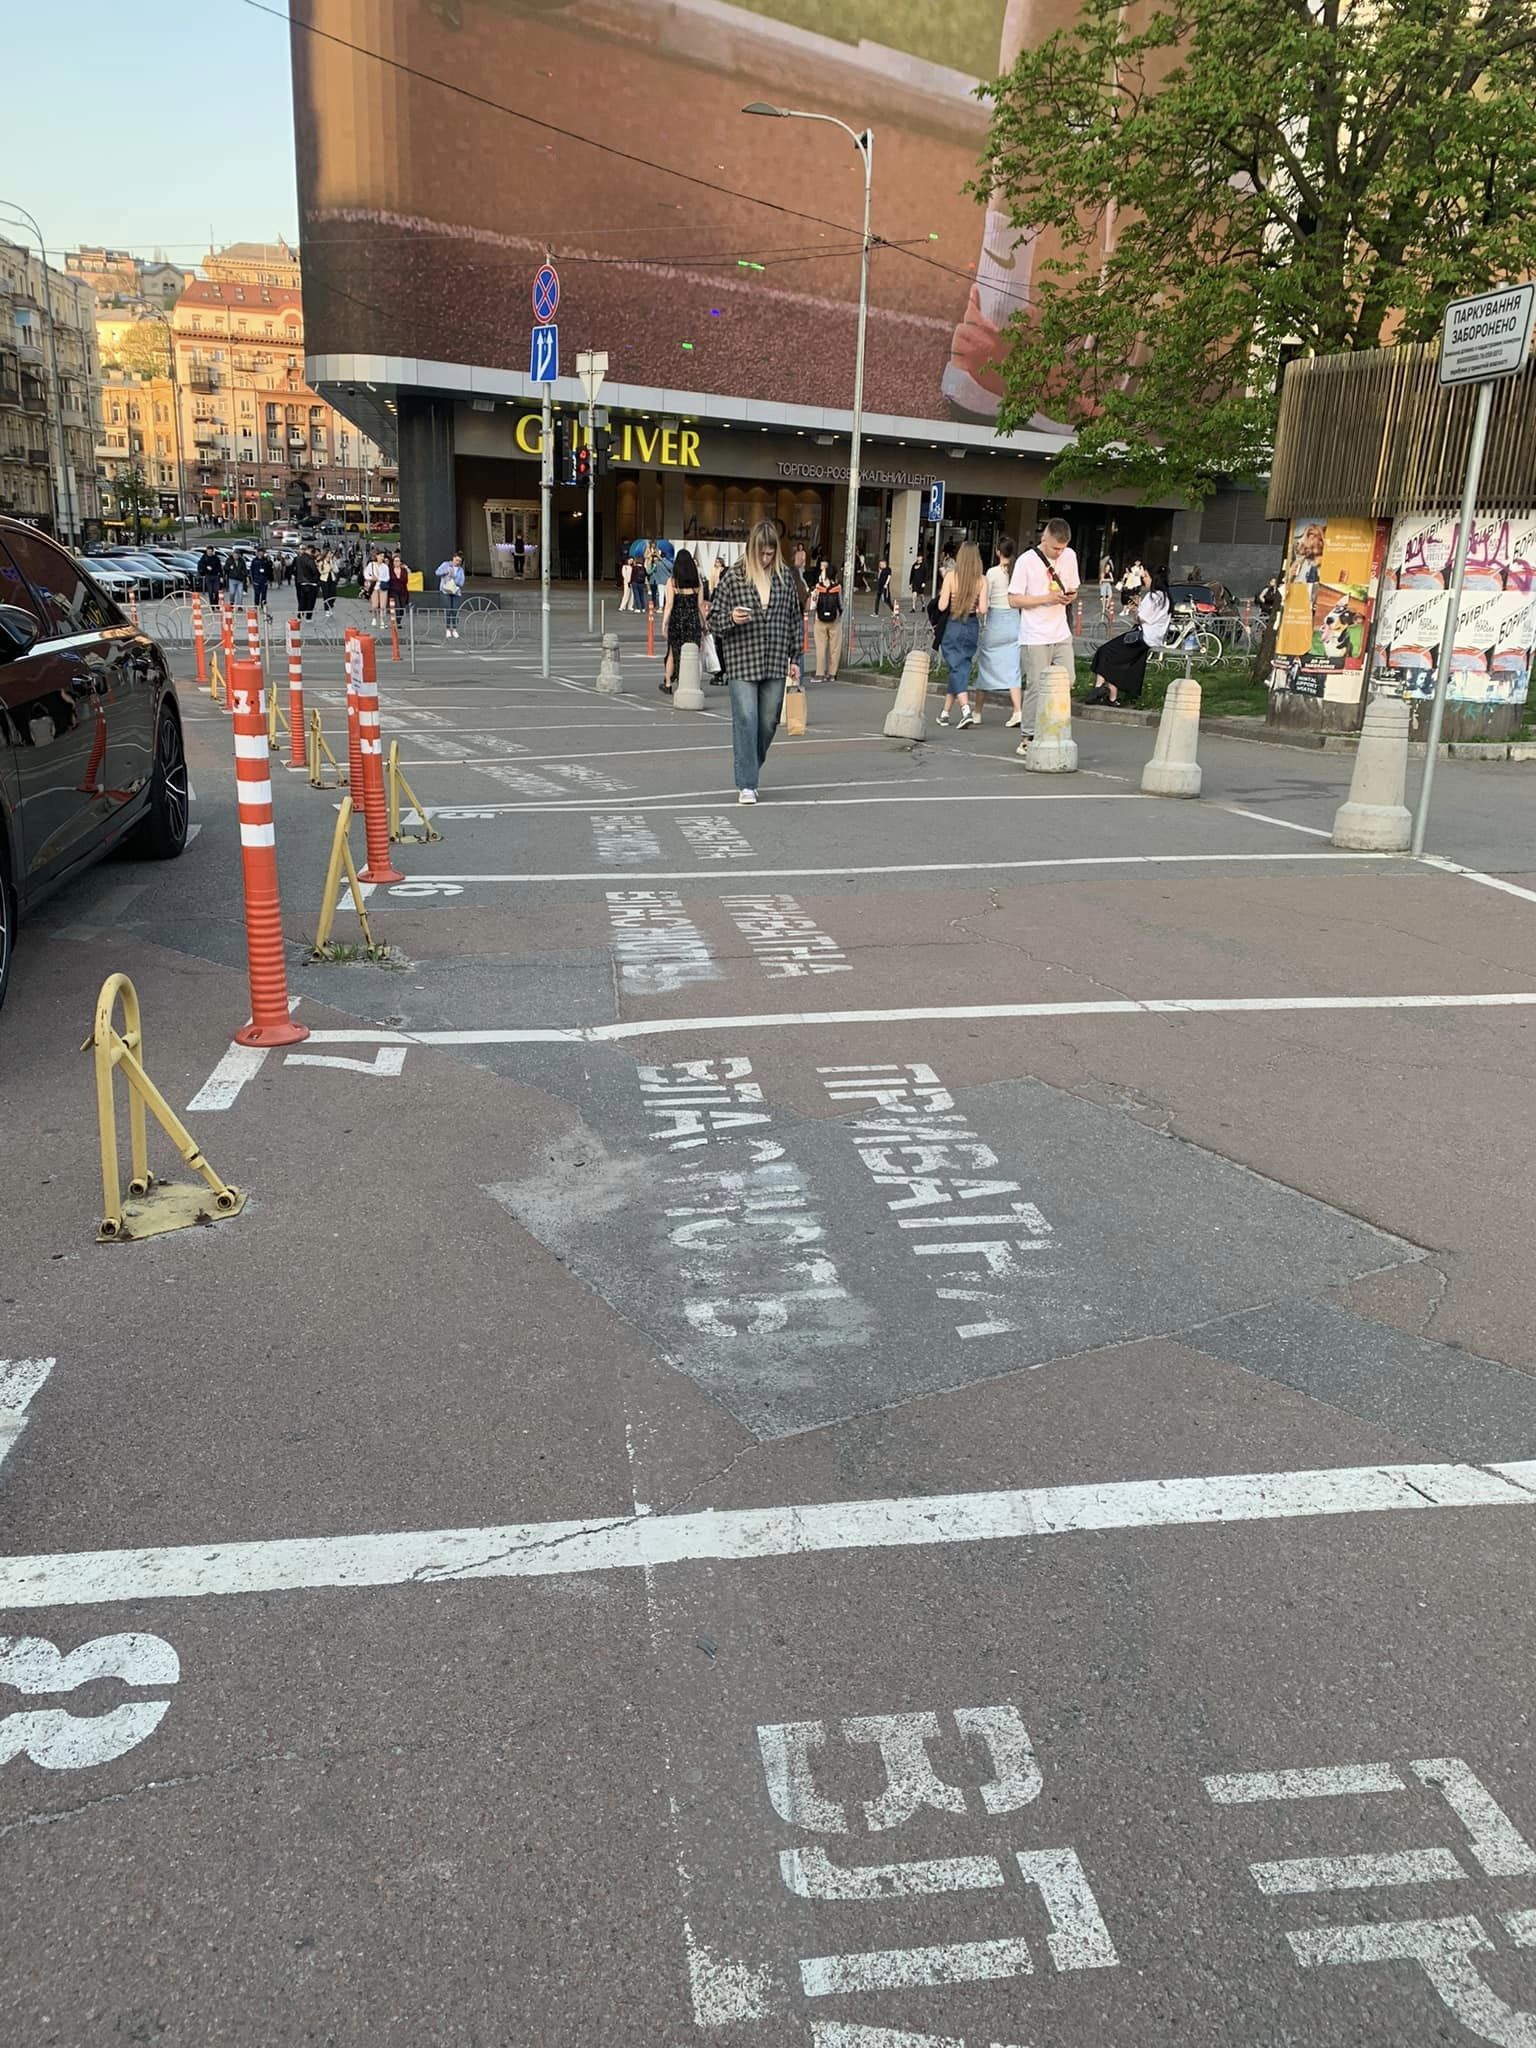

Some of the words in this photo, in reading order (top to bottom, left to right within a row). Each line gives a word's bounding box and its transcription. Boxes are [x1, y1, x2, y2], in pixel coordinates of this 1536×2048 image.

[1453, 295, 1522, 325] ПАРКУВАННЯ
[1451, 317, 1517, 344] ЗАБОРОНЕНО
[718, 893, 854, 979] ПРИВАТНА
[282, 1048, 407, 1077] 7
